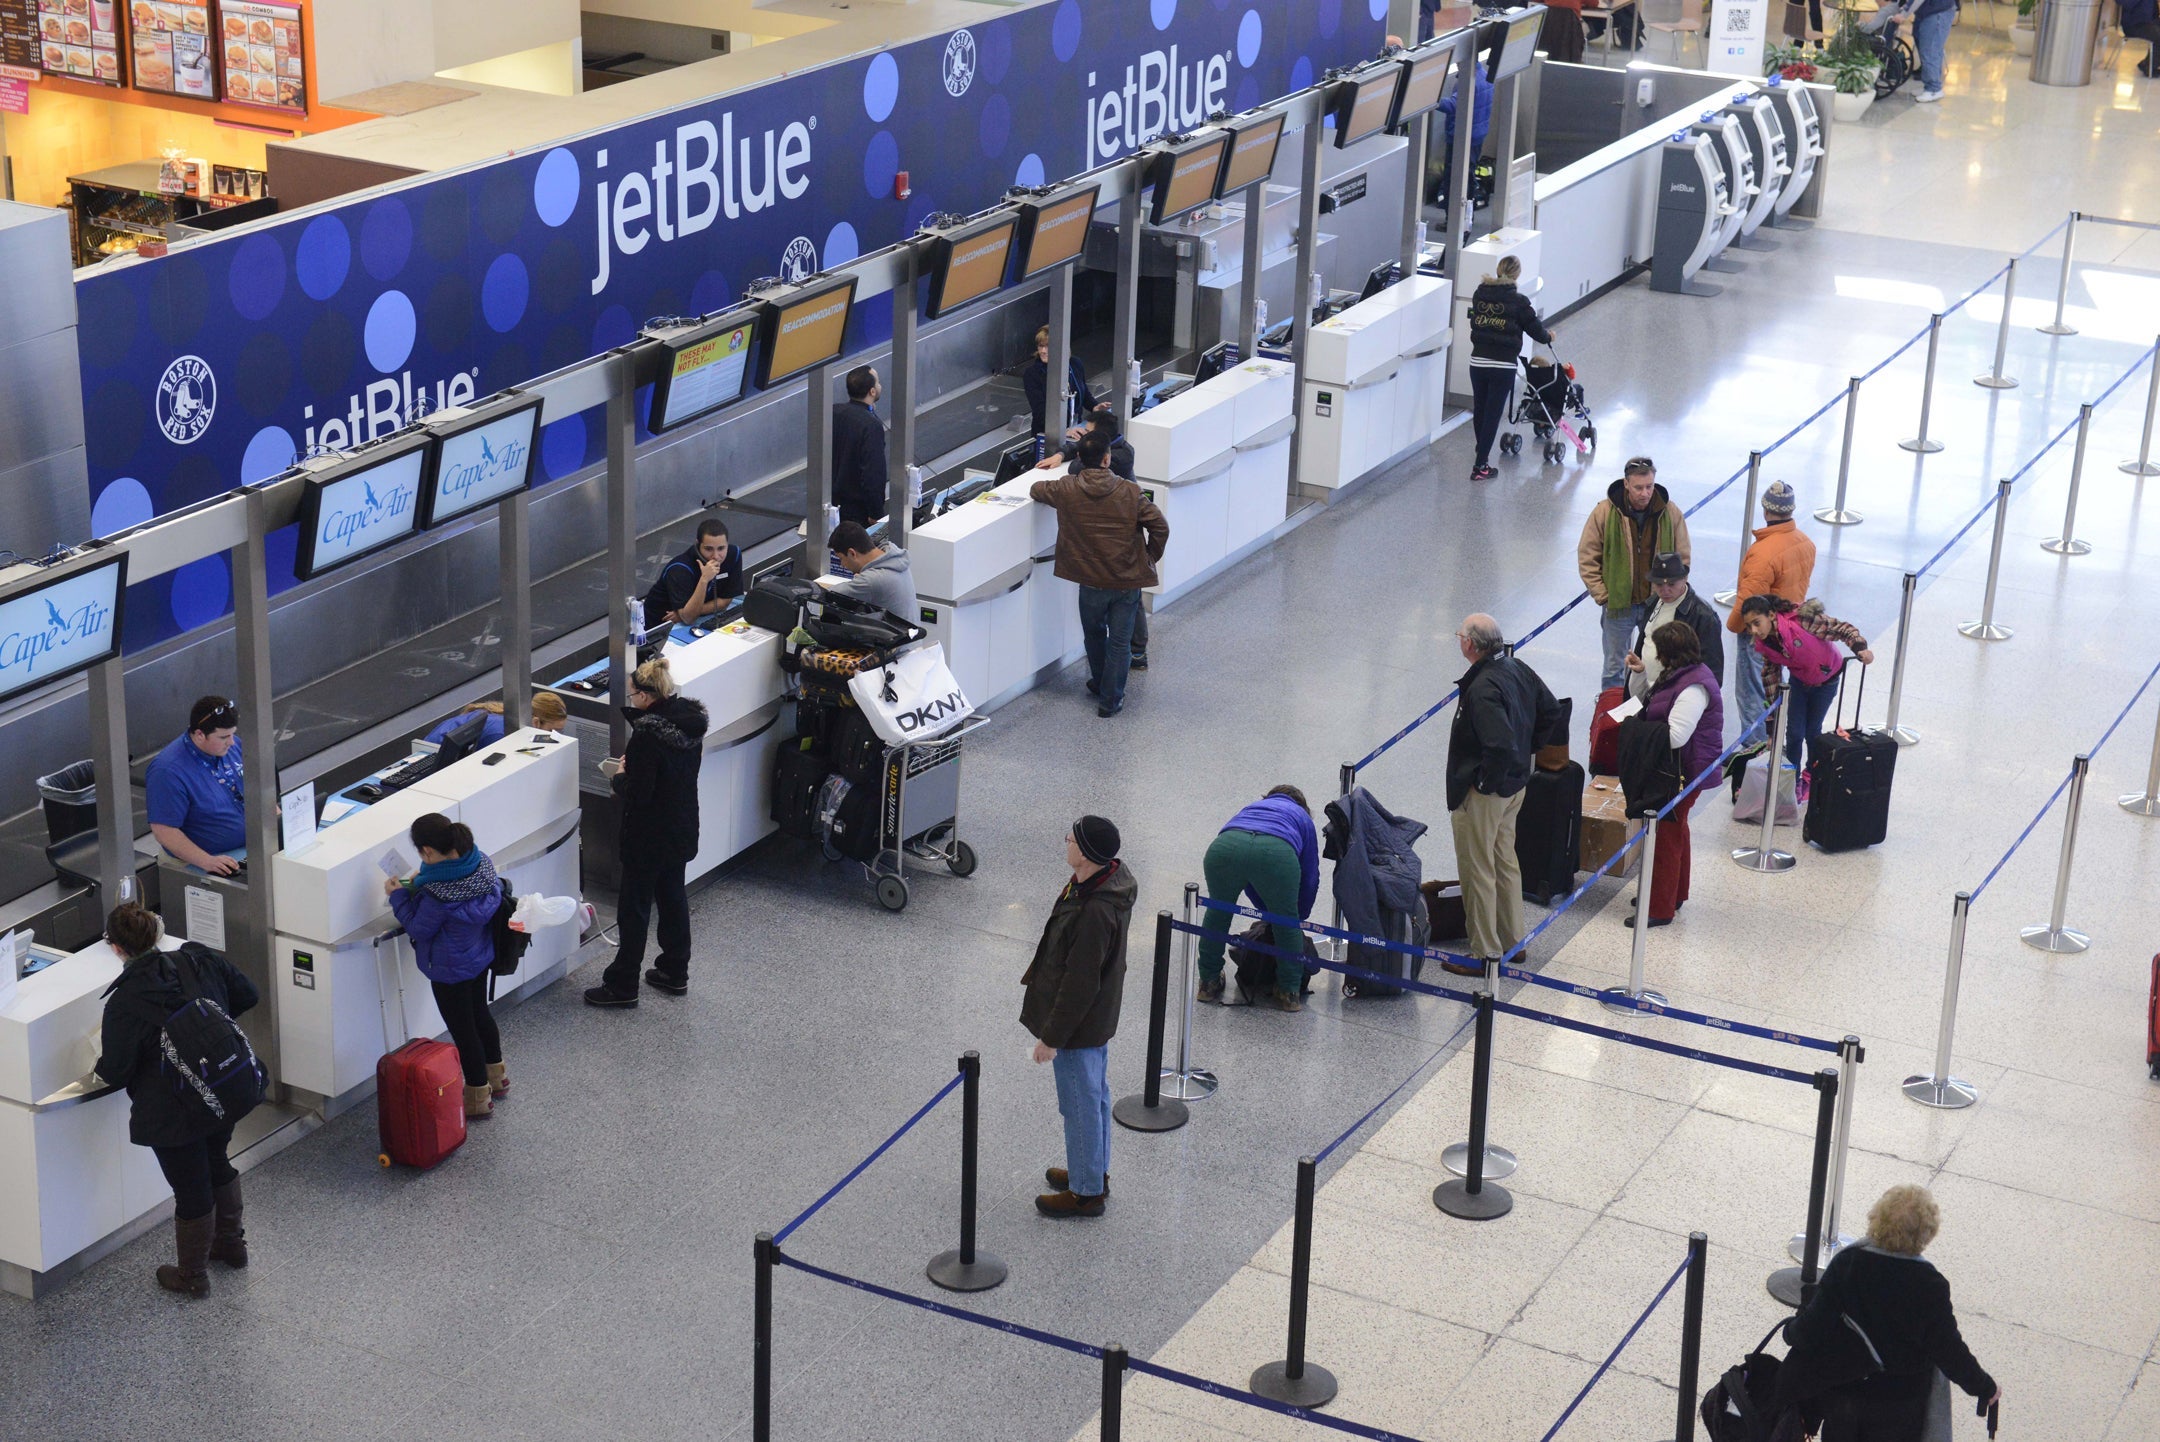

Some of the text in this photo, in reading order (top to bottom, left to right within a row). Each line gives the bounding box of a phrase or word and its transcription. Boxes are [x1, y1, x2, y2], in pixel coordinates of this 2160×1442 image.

[252, 6, 274, 15] COMBOS
[948, 33, 973, 57] BOSTON
[960, 69, 973, 91] SOX
[1086, 44, 1228, 172] jetBlue
[1670, 183, 1695, 193] jetBlue
[592, 111, 812, 296] jetBlue
[1039, 206, 1090, 233] REACCOMMODATION
[785, 240, 814, 267] BOSTON
[953, 238, 1008, 267] REACCOMMODATION
[782, 301, 847, 334] REACCOMMODATION
[680, 341, 716, 362] THESE MAY
[162, 360, 209, 394] BOSTON
[677, 361, 692, 373] NOT
[164, 405, 211, 440] RED SOX
[304, 370, 475, 456] jetBlue
[442, 439, 526, 499] Cape Air
[322, 483, 414, 547] Cape Air
[0, 600, 109, 673] Cape Air
[895, 688, 965, 733] DKNY
[1240, 907, 1263, 918] jetBlue
[1362, 935, 1386, 948] jetBlue
[1573, 984, 1598, 998] jetBlue
[1705, 1016, 1732, 1030] jetBlue
